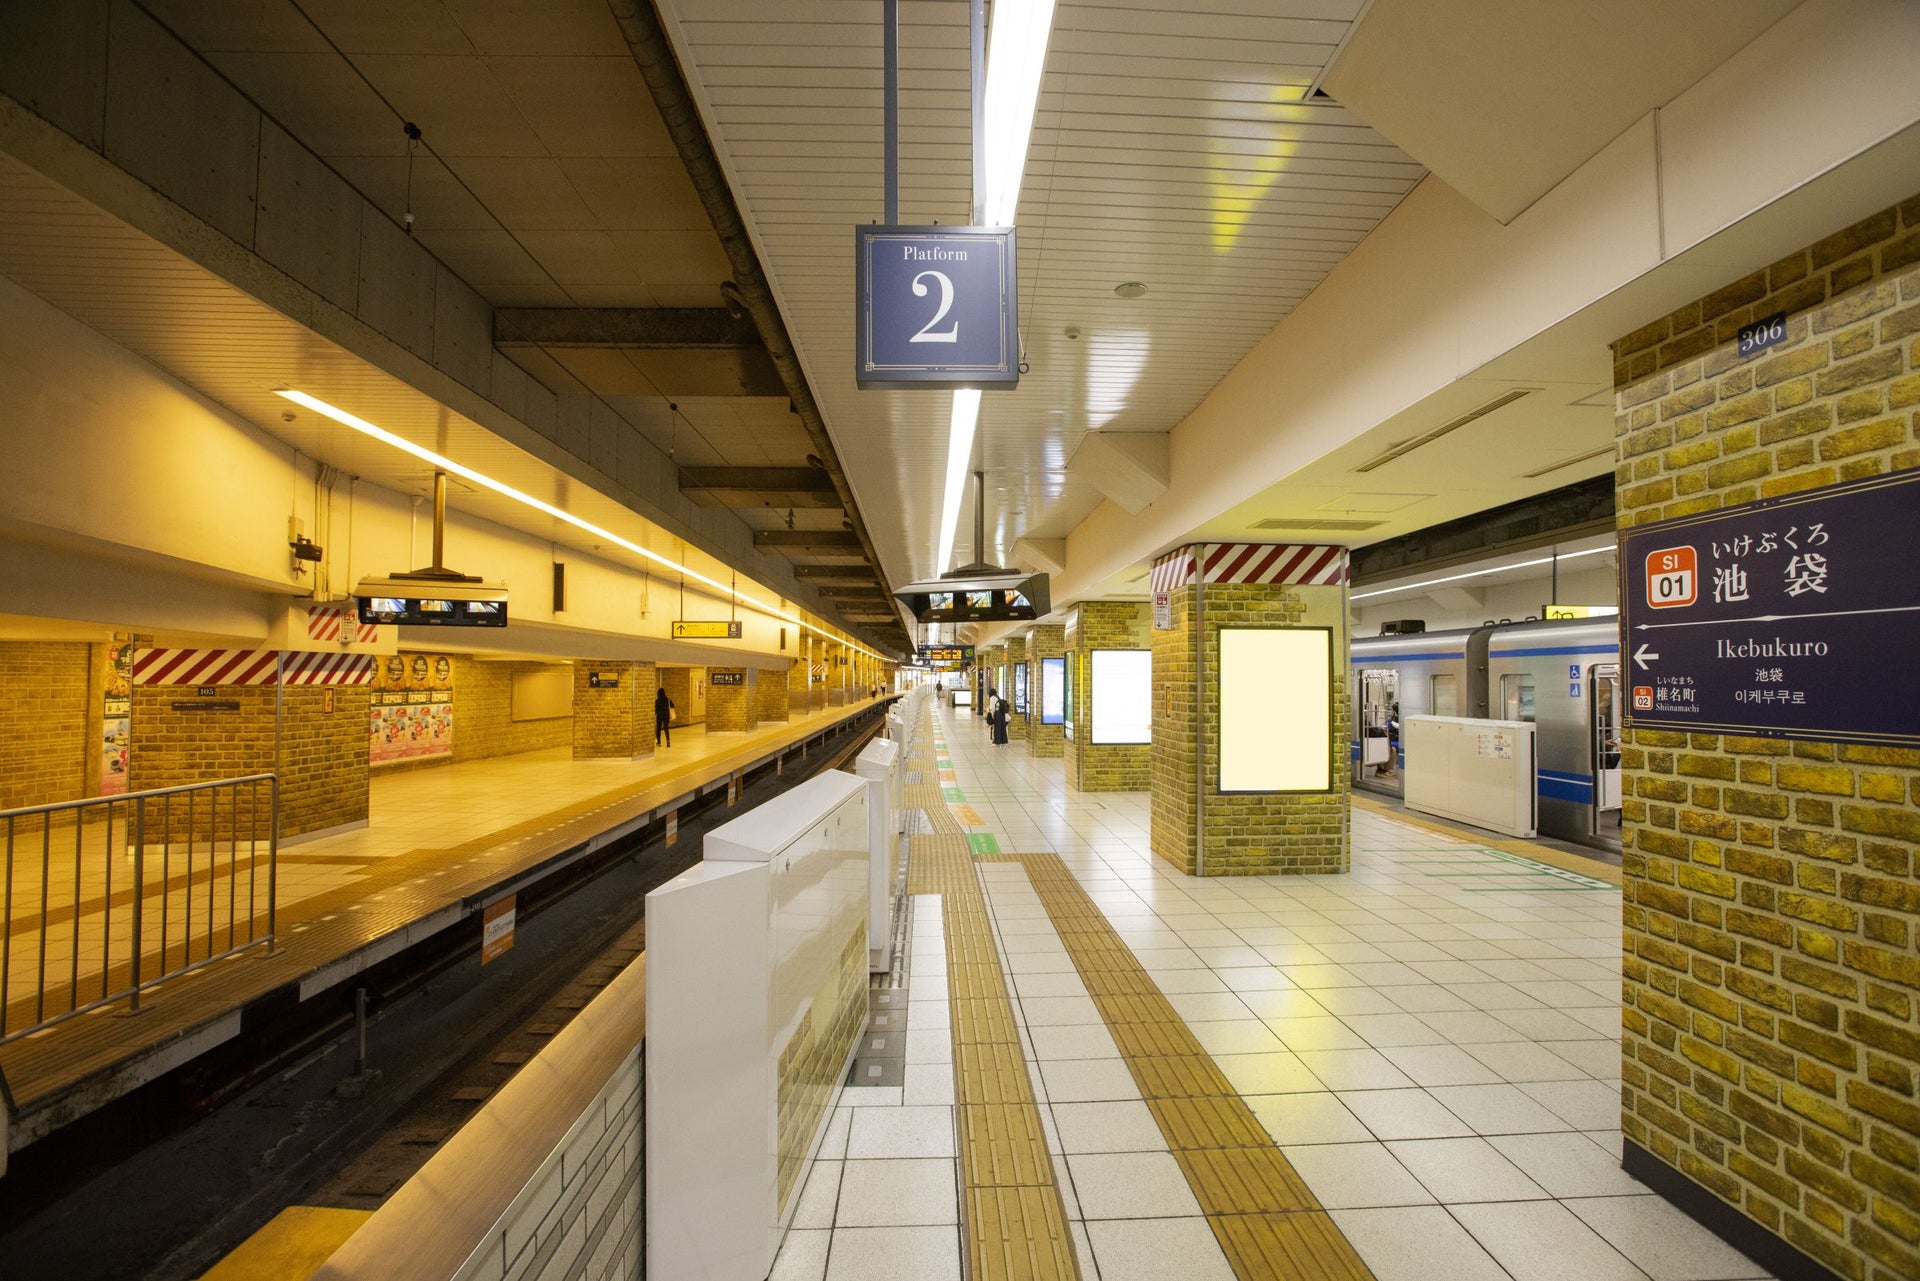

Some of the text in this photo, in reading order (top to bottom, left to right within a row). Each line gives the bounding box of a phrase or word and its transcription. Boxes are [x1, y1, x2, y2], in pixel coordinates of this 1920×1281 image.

[903, 246, 968, 261] Platform
[909, 270, 959, 343] 2
[1742, 318, 1782, 351] 306
[1712, 523, 1829, 559] いけぶくろ
[1662, 554, 1680, 571] SI
[1659, 575, 1685, 597] 01
[1712, 553, 1828, 603] 池袋
[1717, 637, 1829, 659] Ikebukuro
[1656, 676, 1694, 685] しいなまち
[1755, 668, 1784, 682] 池袋
[1637, 697, 1649, 706] 02
[1656, 687, 1697, 702] 椎名町
[1735, 689, 1806, 705] 이케부쿠로
[1655, 702, 1700, 713] Shiinamachi
